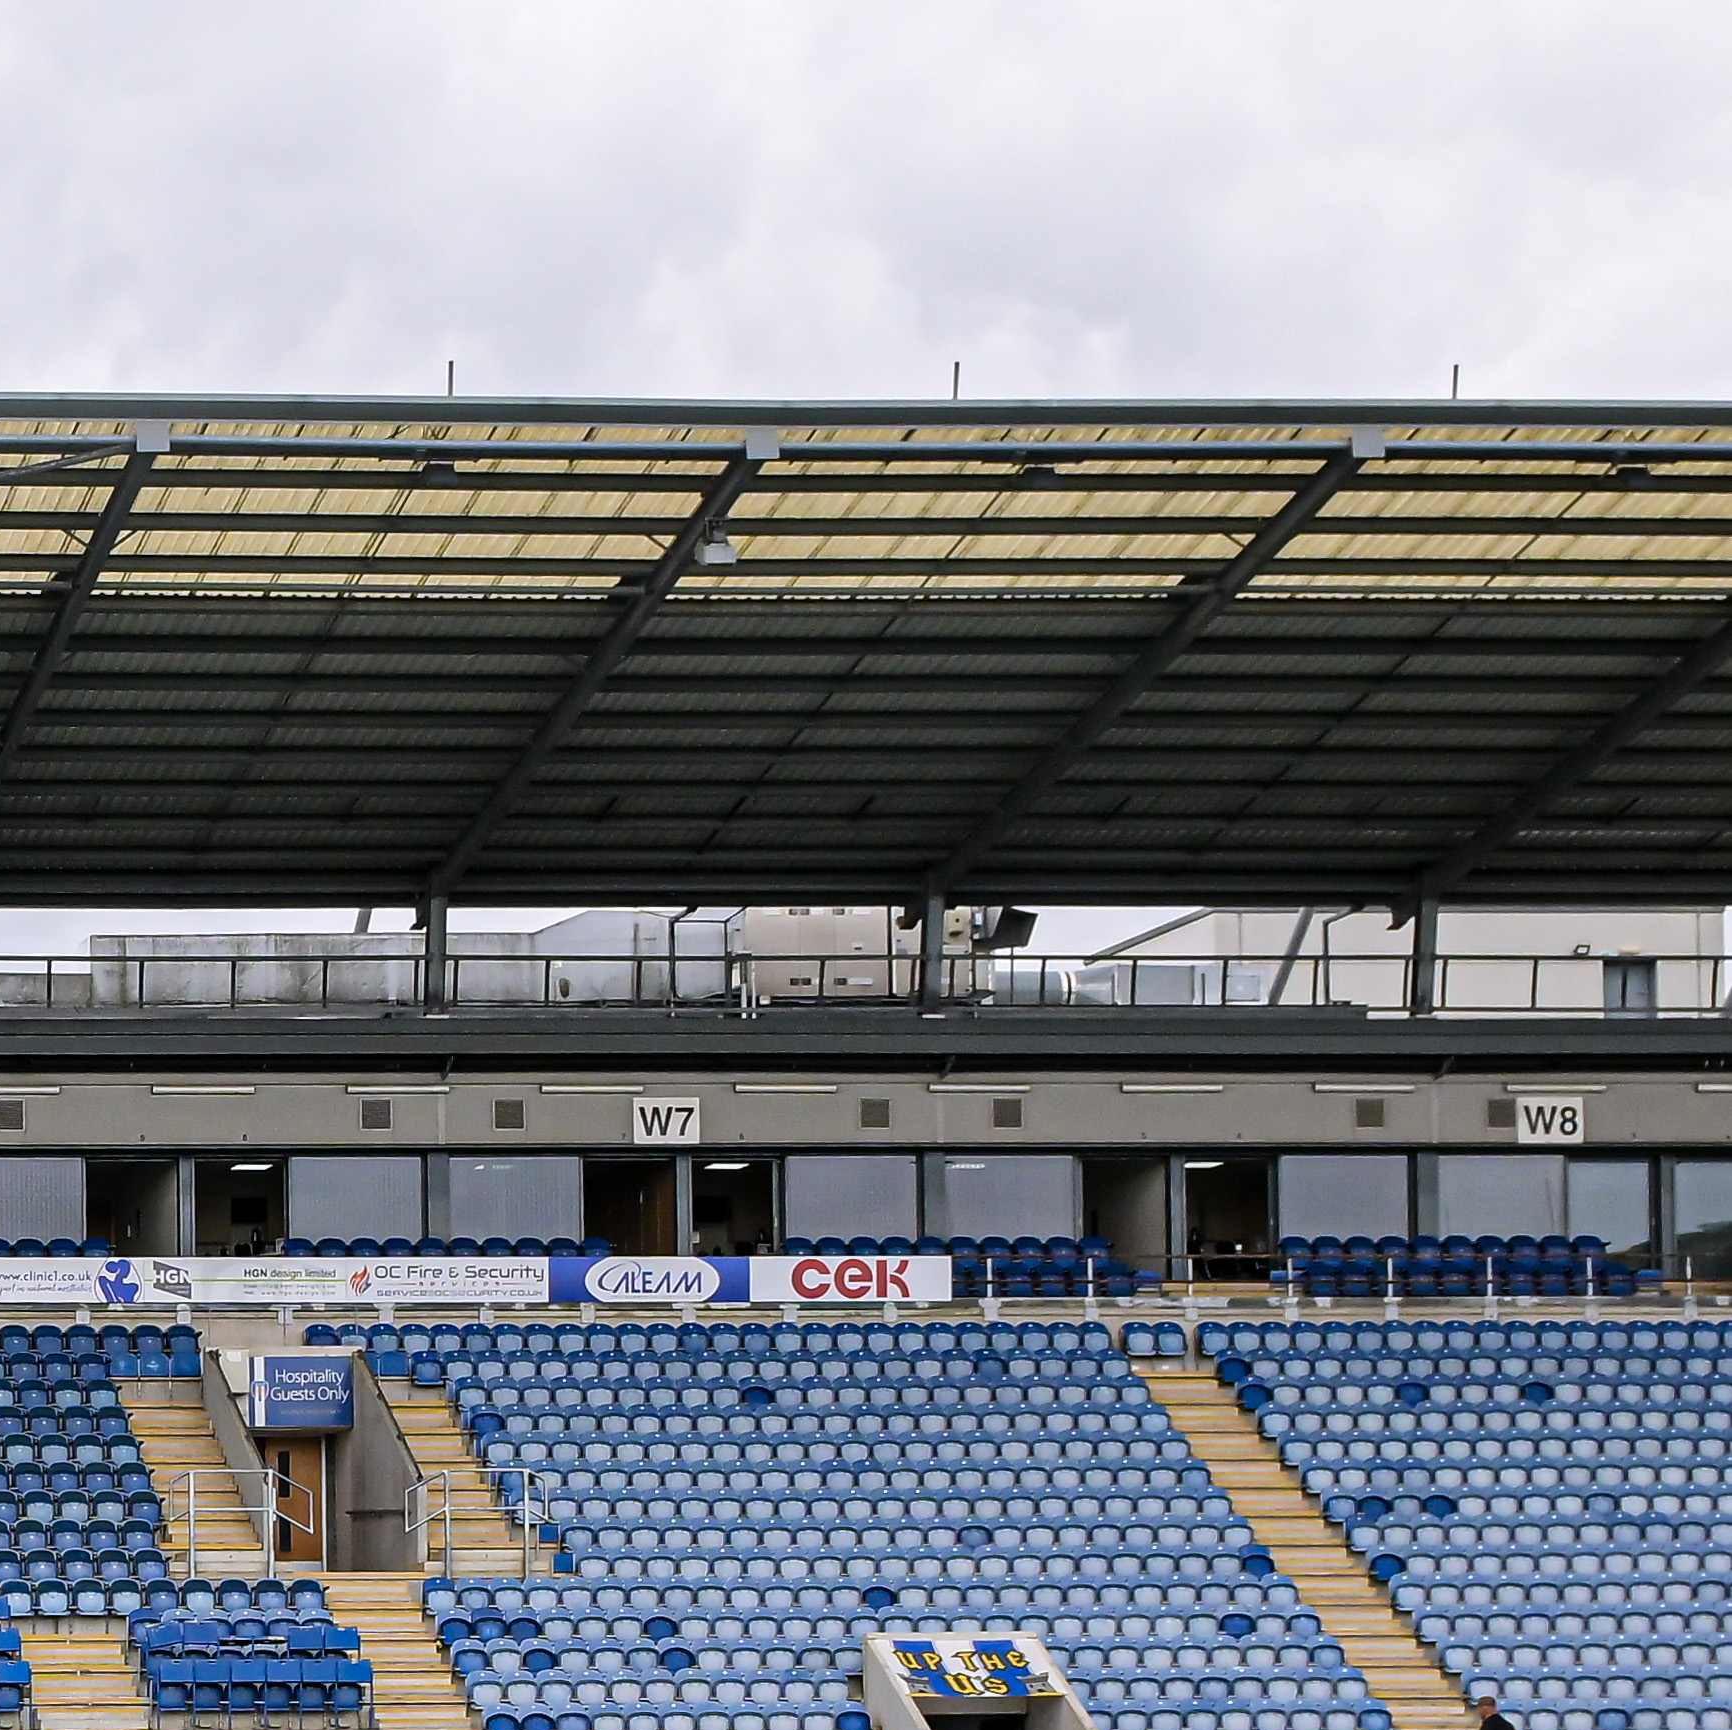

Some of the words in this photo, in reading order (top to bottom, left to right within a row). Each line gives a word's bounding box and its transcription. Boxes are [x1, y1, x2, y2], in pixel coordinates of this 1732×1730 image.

[638, 1106, 695, 1137] W7
[1523, 1105, 1579, 1136] W8
[243, 1268, 268, 1278] HGN
[270, 1268, 303, 1280] design
[304, 1268, 337, 1278] limited
[374, 1265, 401, 1279] OC
[407, 1264, 443, 1278] Fire
[449, 1266, 459, 1278] &
[465, 1264, 544, 1282] Security
[275, 1368, 344, 1388] Hospitality
[270, 1386, 315, 1402] Guests
[317, 1386, 349, 1404] Only
[893, 1650, 943, 1672] UP
[951, 1650, 1029, 1673] THE
